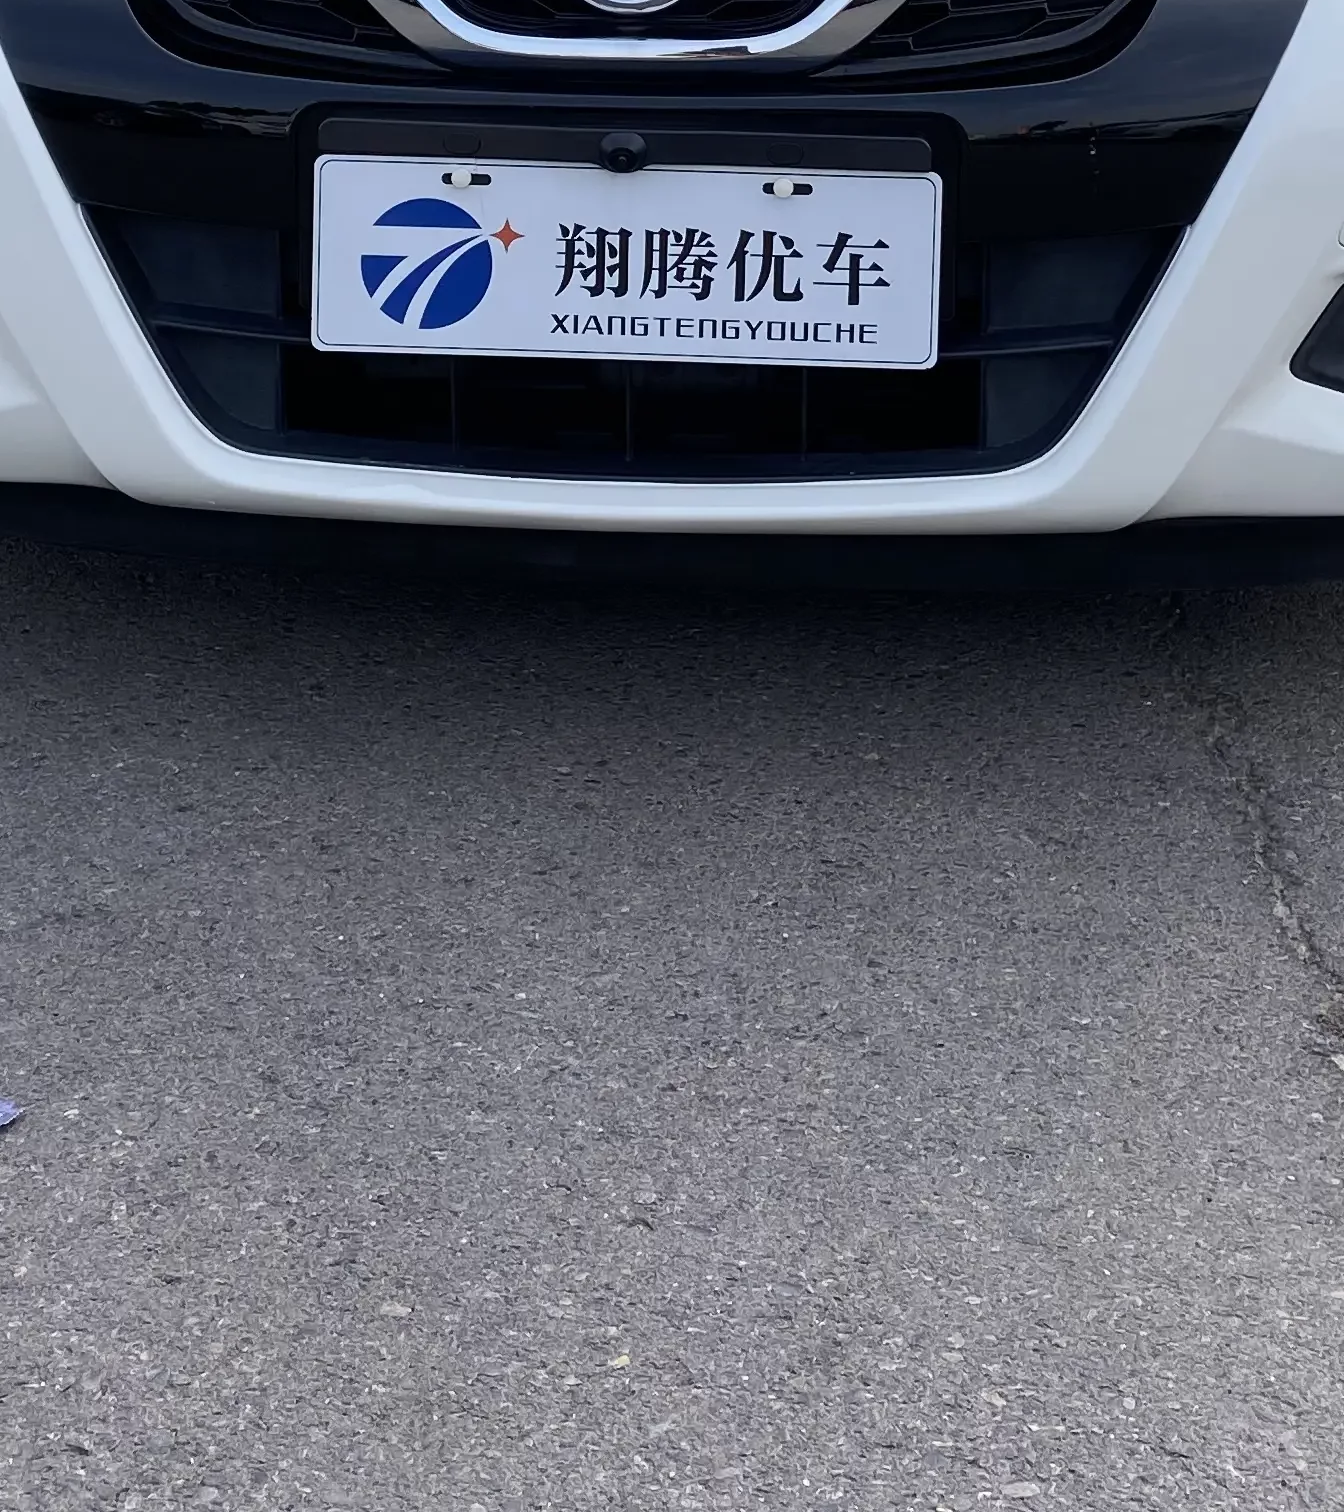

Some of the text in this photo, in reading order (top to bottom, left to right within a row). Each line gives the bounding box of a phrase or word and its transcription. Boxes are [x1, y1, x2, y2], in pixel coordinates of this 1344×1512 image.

[554, 222, 892, 306] 翔腾优车
[550, 313, 879, 345] XIANGTENGYOUCHE
